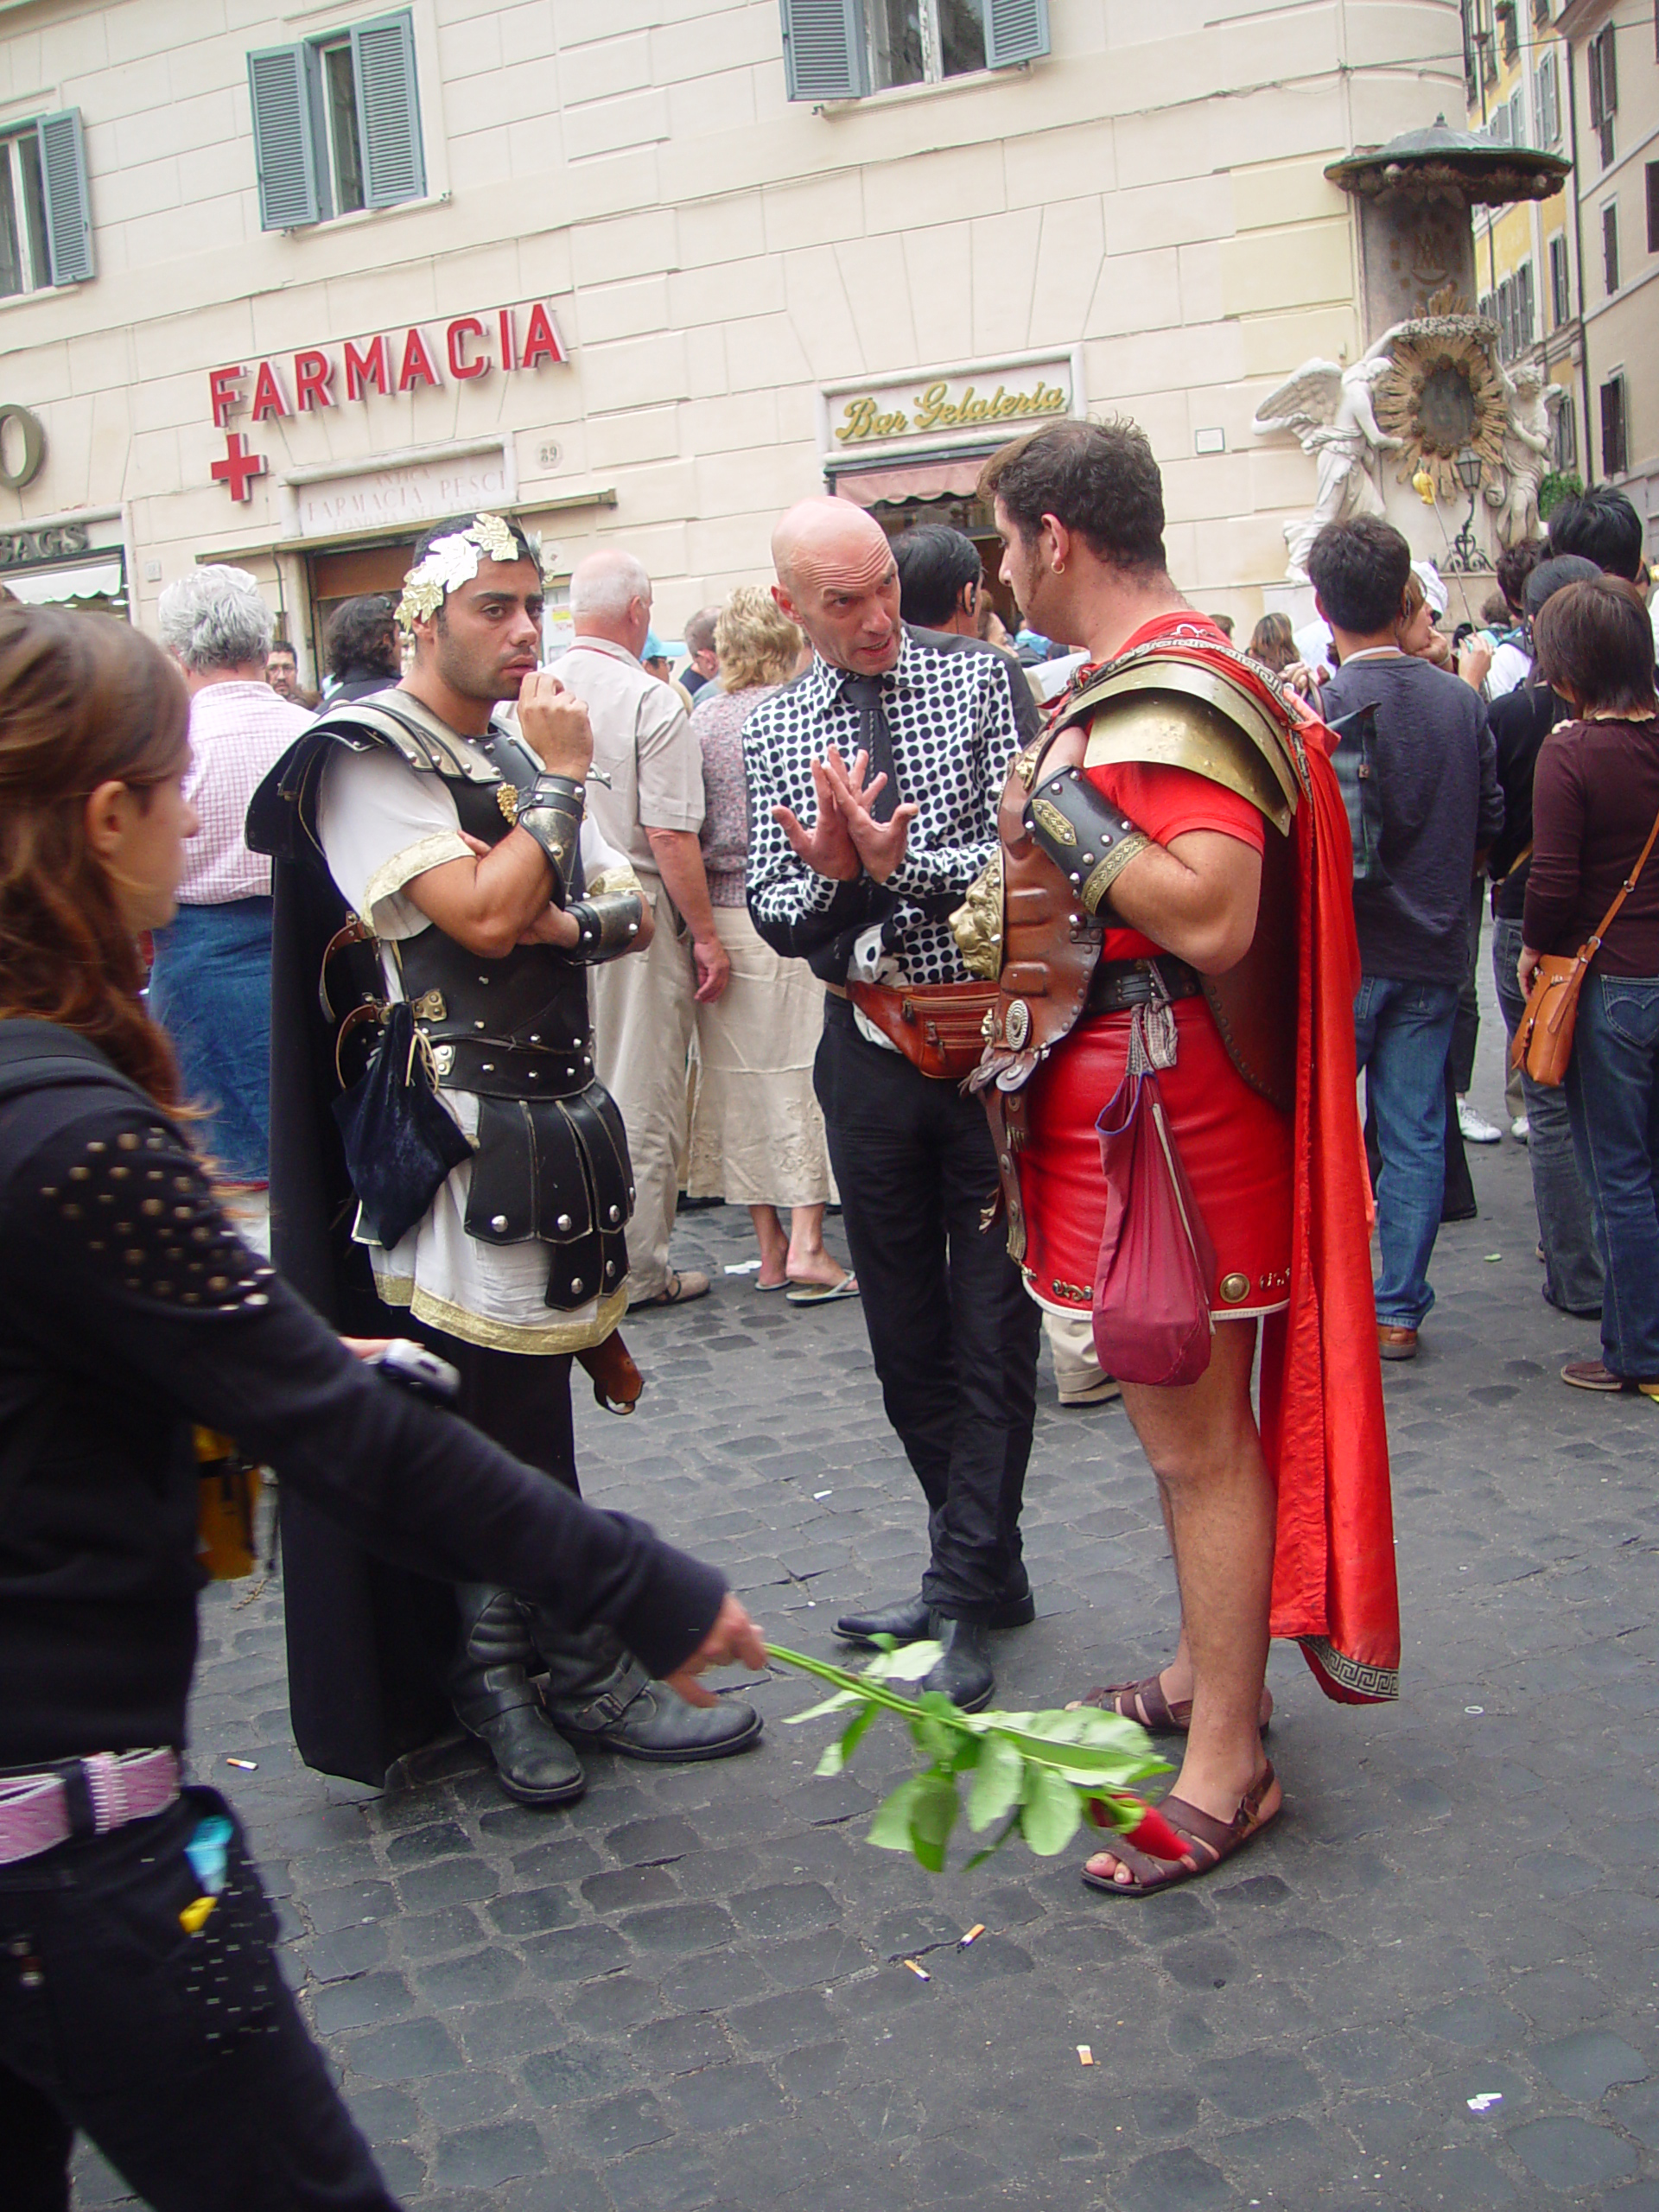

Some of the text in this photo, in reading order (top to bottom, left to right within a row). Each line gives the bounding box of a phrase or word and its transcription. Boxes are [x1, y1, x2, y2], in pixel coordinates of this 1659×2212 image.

[209, 303, 569, 428] FARMACIA
[836, 382, 1065, 439] Bar Gelateria
[540, 446, 558, 464] 89
[308, 470, 505, 521] FARMACIA PESCI
[0, 524, 88, 562] BAGS
